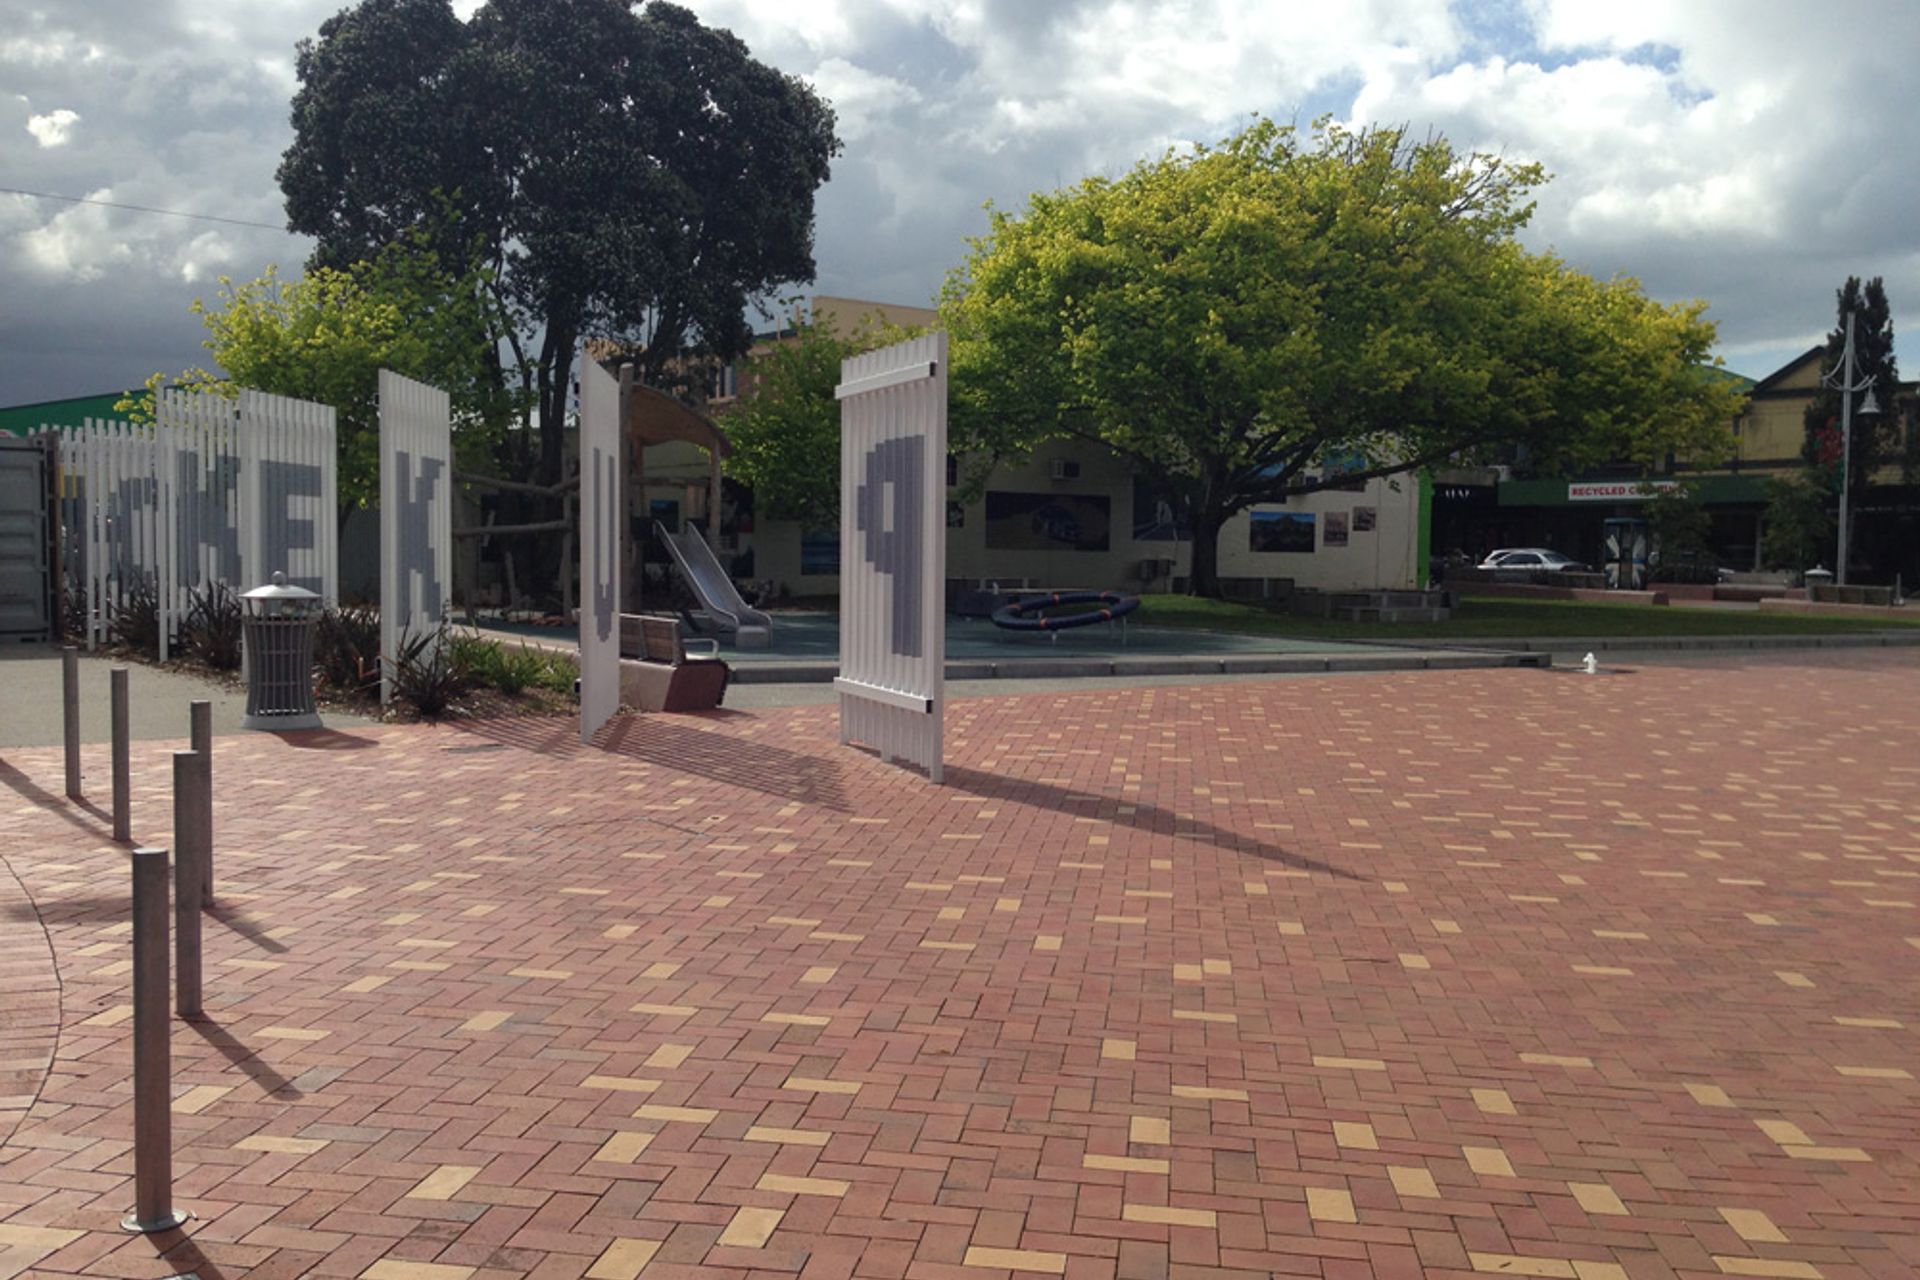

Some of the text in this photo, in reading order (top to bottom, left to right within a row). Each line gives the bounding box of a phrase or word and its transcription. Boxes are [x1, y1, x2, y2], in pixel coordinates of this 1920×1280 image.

[259, 460, 323, 608] E
[396, 451, 445, 627] K
[1570, 485, 1626, 497] RECYCLED
